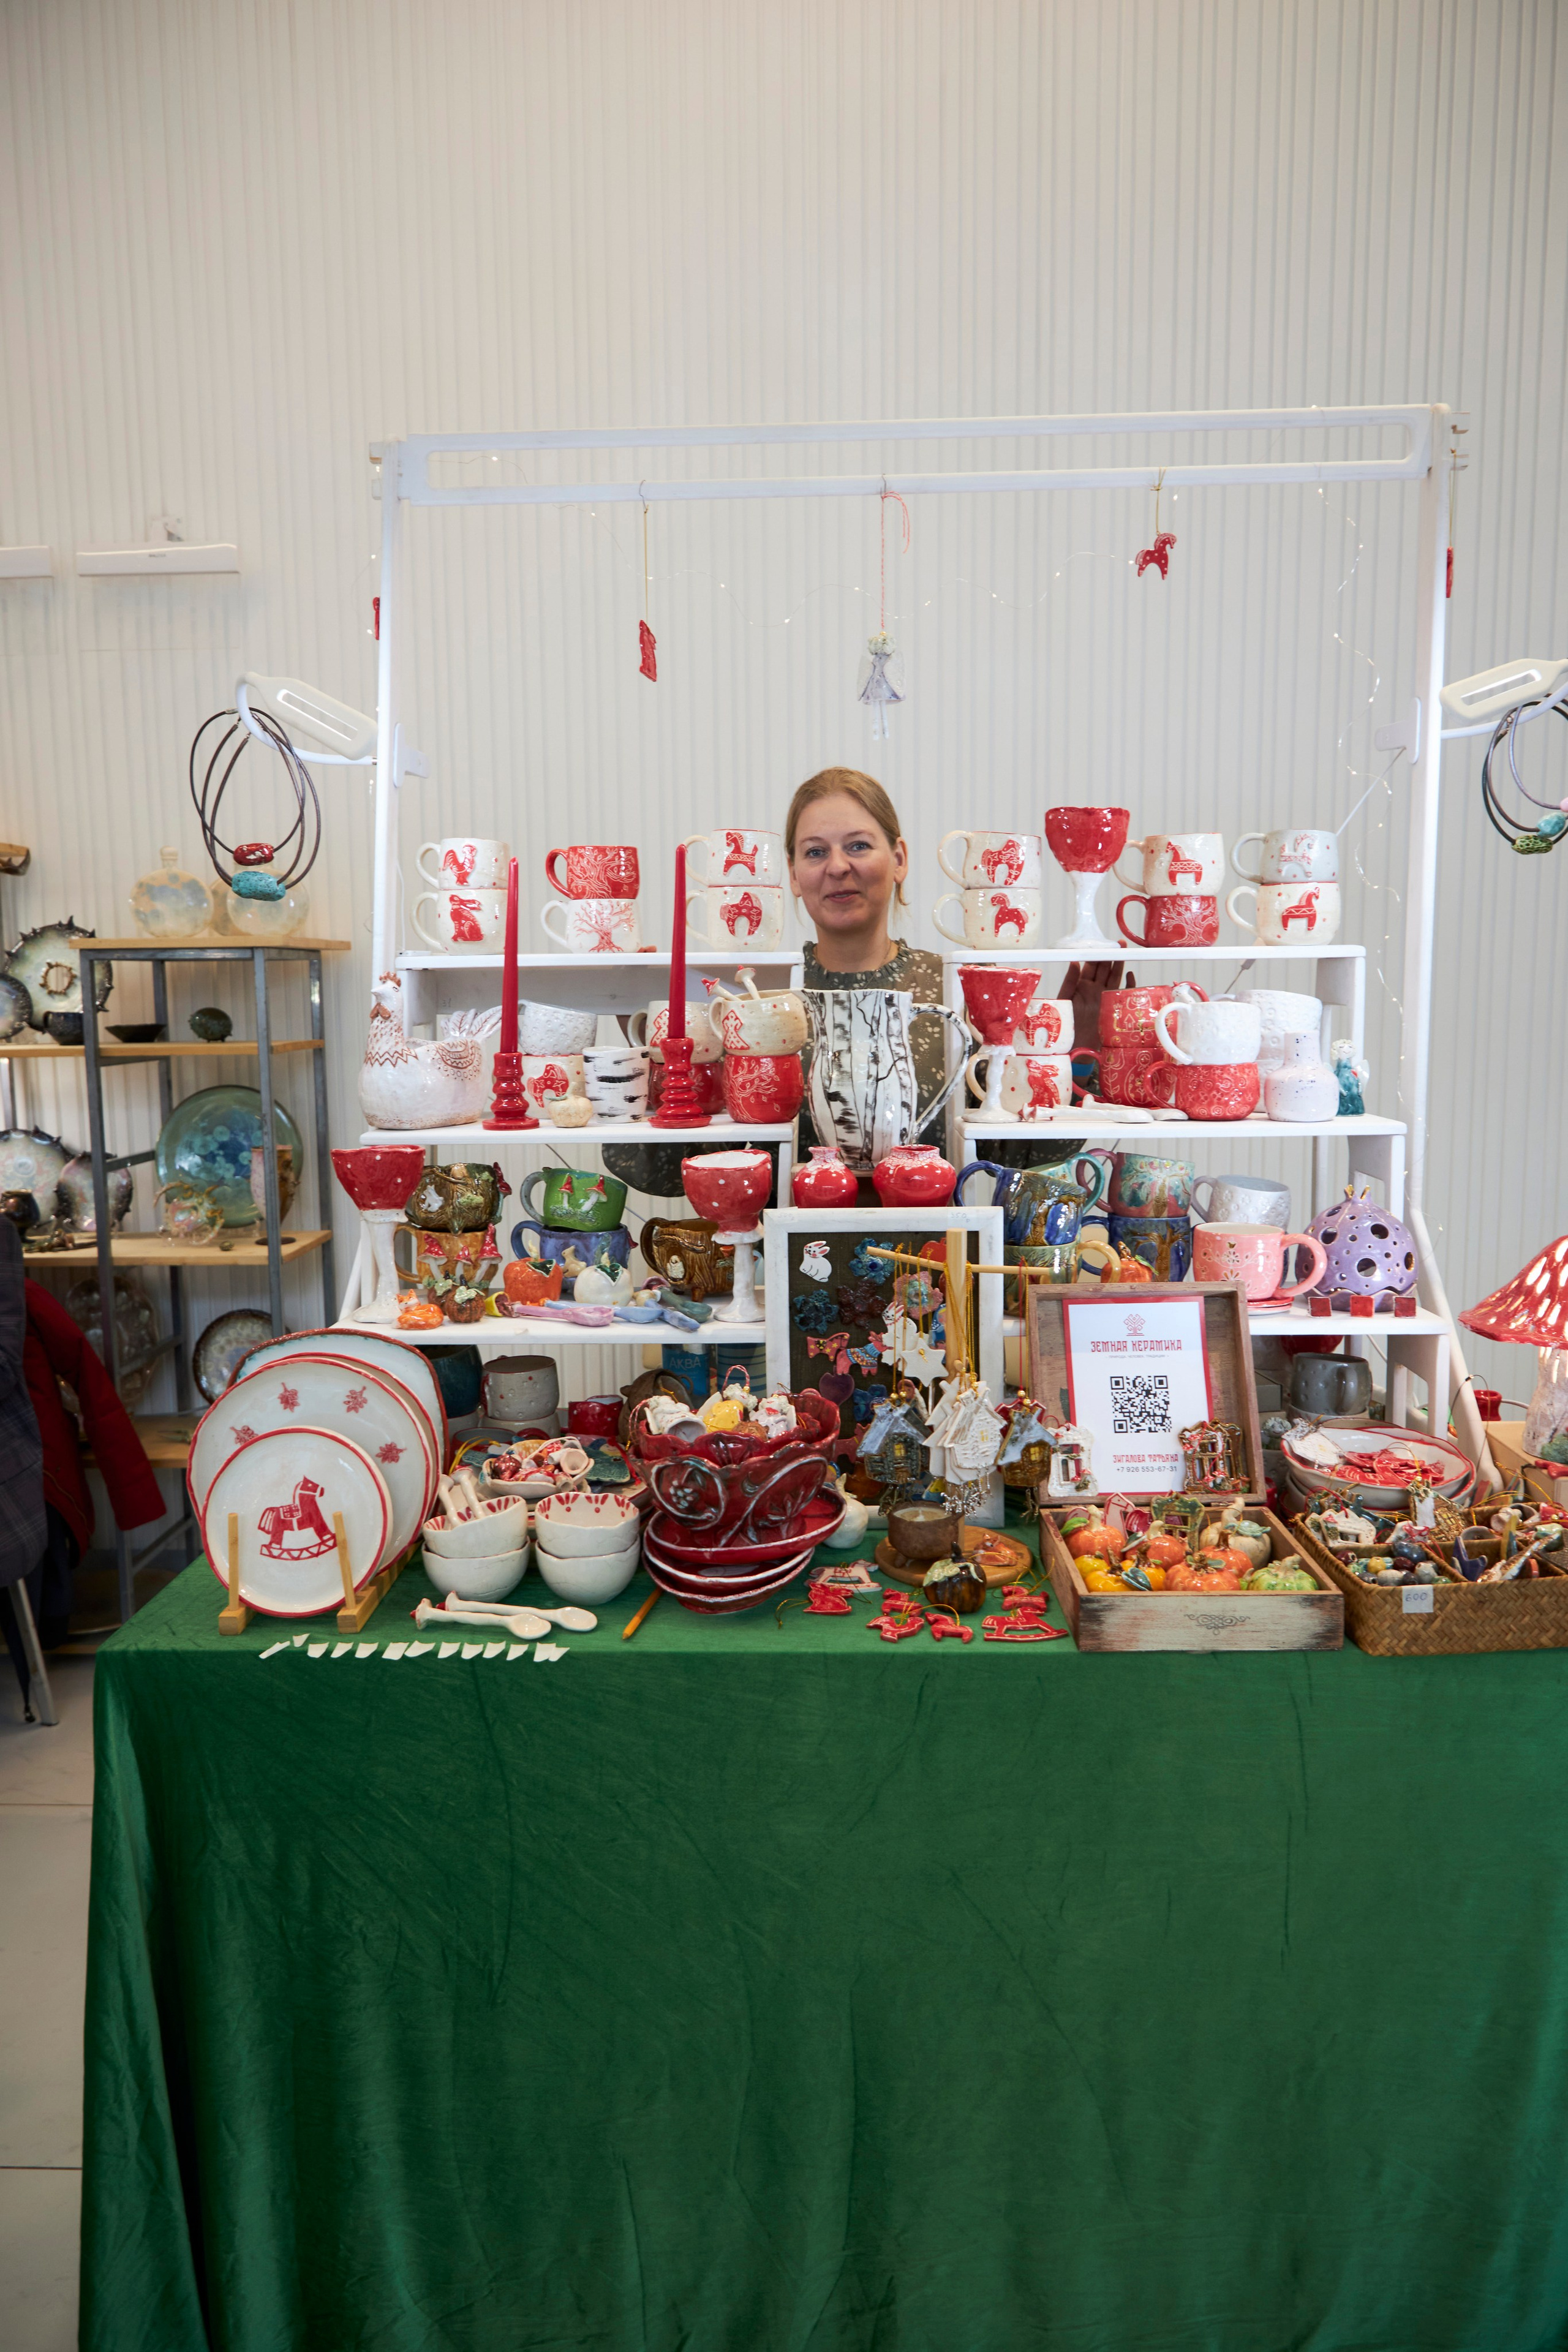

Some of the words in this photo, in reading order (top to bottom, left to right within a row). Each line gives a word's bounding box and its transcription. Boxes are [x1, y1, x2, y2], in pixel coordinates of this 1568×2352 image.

[1091, 1340, 1128, 1352] ЗЕМНАЯ
[1131, 1340, 1182, 1351] КЕРАМИКА
[669, 1356, 701, 1371] АКВА
[1113, 1454, 1145, 1463] ЗИГАЛОВА
[1148, 1453, 1178, 1463] ТАТЬЯНА
[1405, 1593, 1427, 1602] 600
